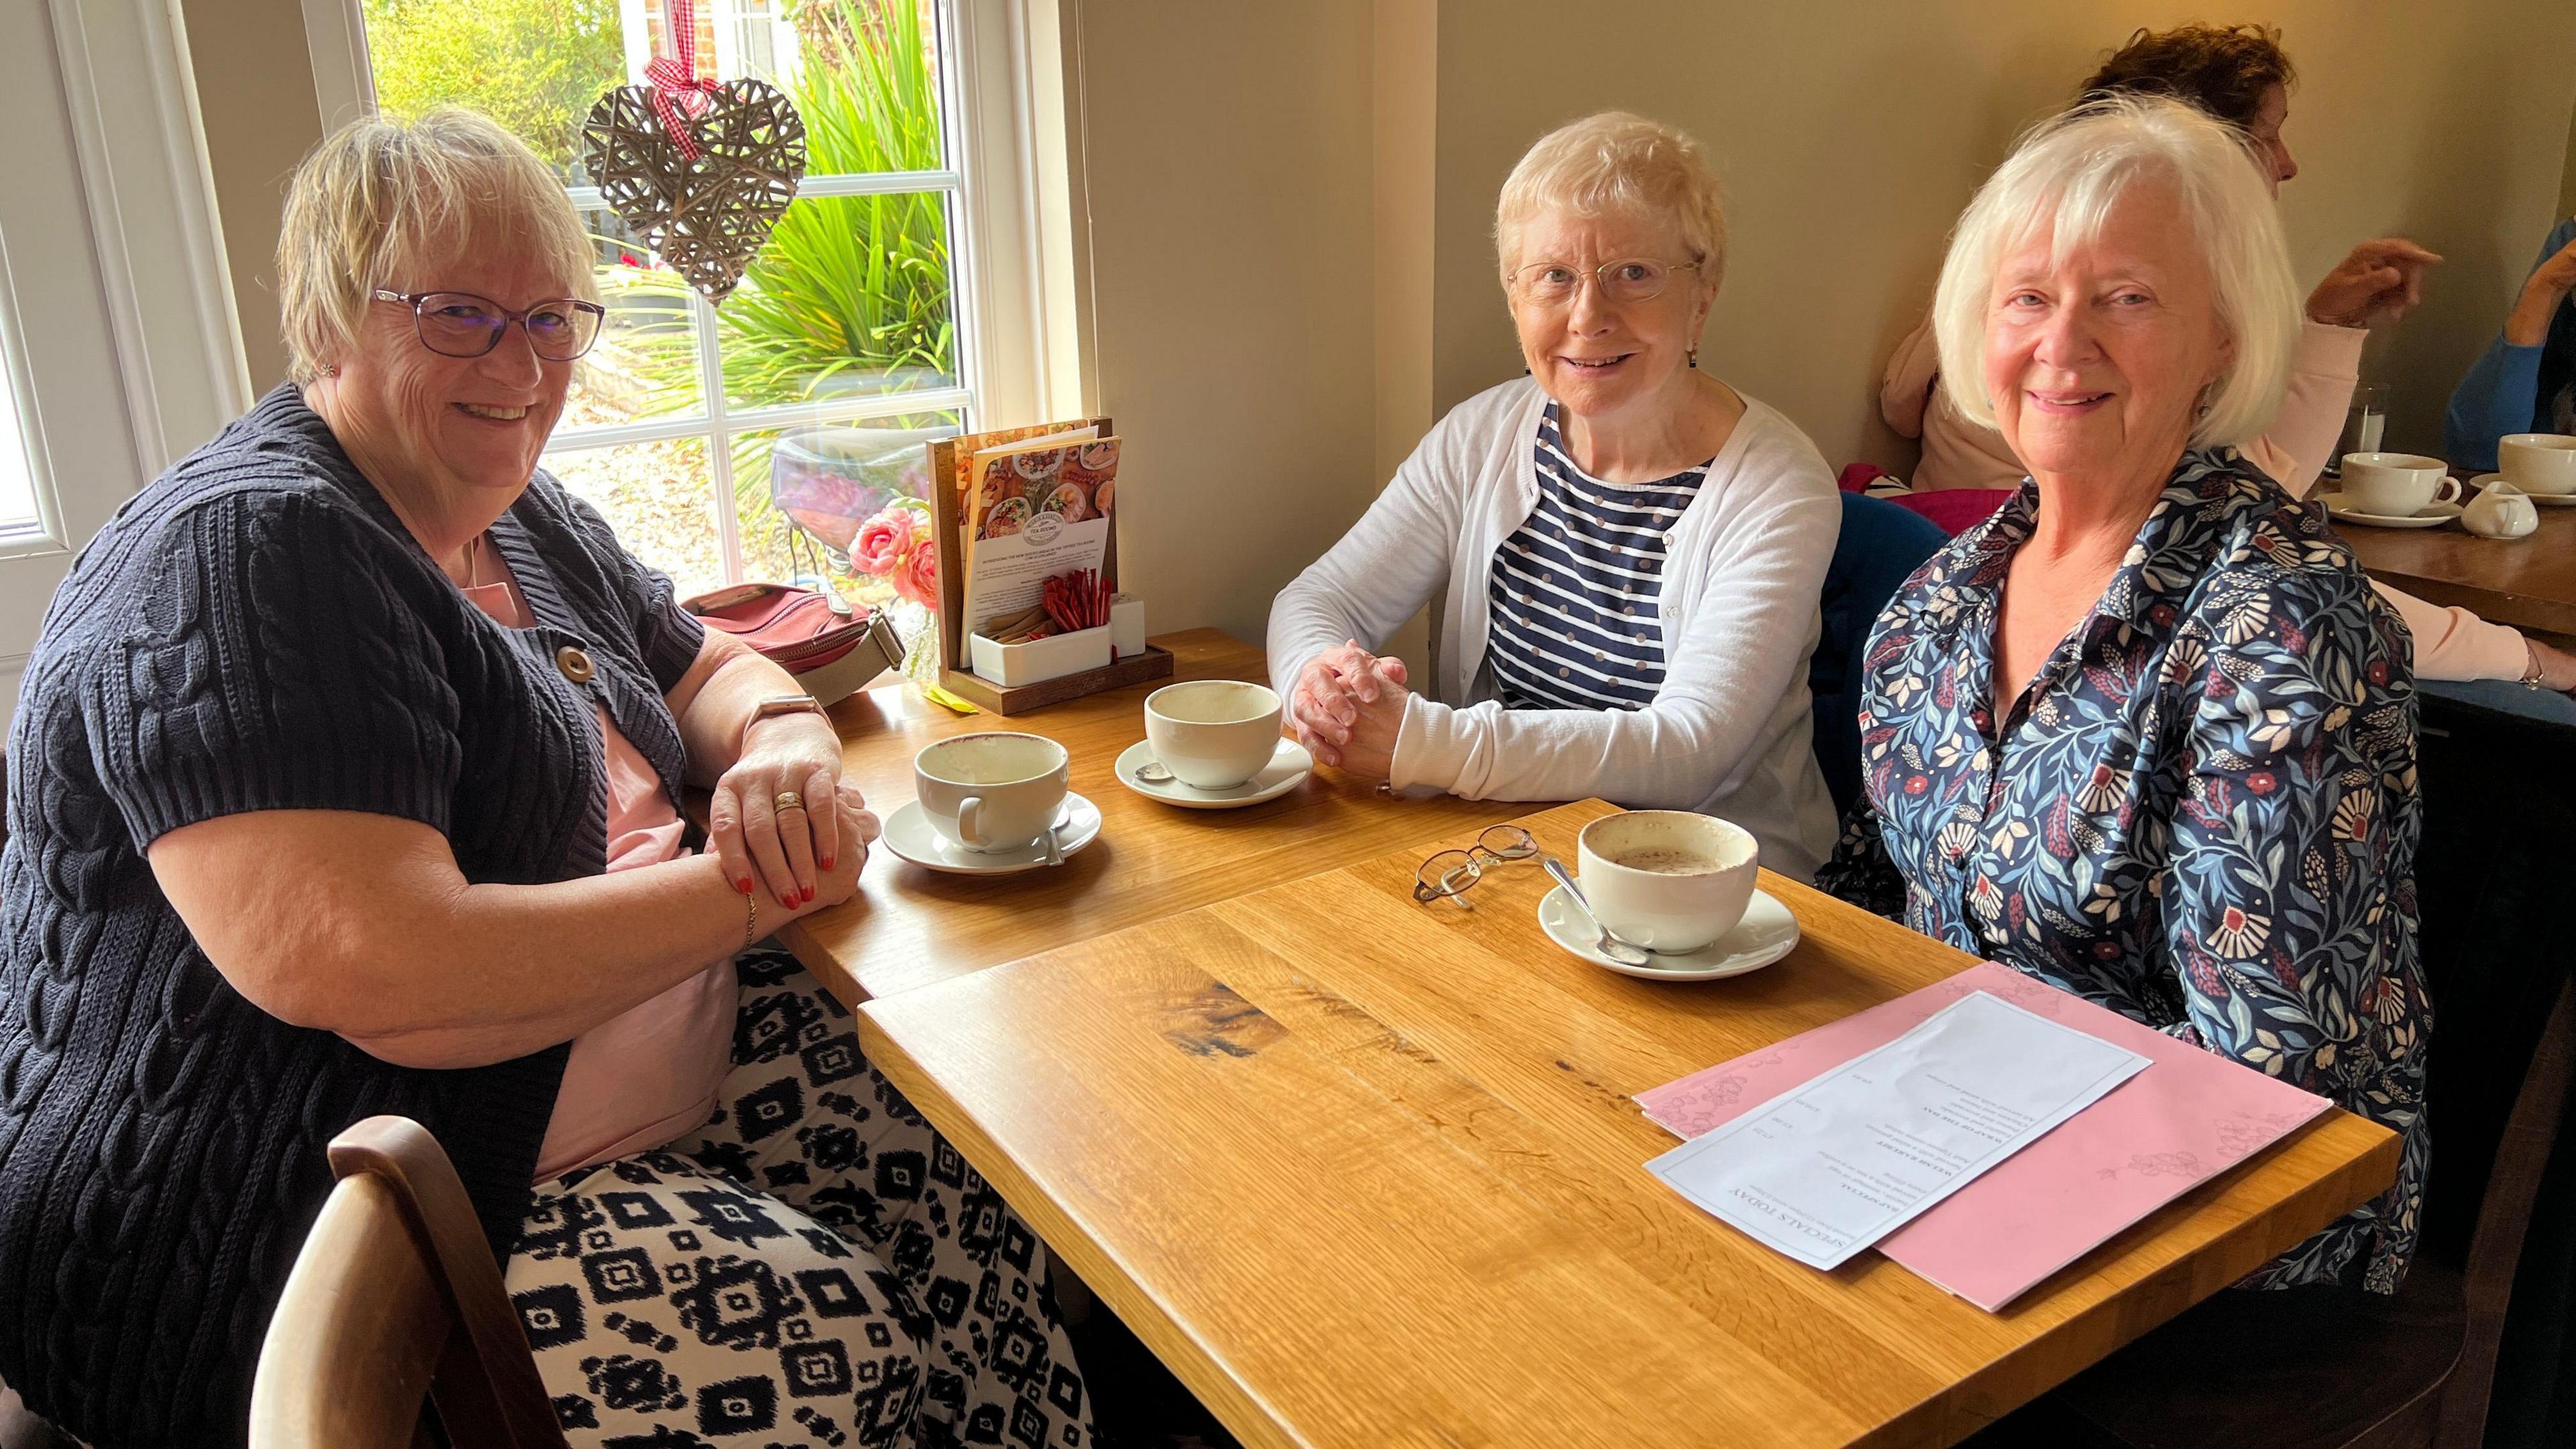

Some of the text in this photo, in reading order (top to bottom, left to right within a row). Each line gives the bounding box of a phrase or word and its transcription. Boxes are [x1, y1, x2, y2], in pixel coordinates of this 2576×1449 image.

[1945, 1083, 1961, 1091] and
[1960, 1089, 1980, 1099] salad
[1960, 1097, 1982, 1110] bacon
[1980, 1098, 1997, 1107] with
[1921, 1106, 1941, 1117] DAY
[1939, 1106, 1970, 1120] avocado
[1949, 1102, 1980, 1116] avocado
[1996, 1105, 2023, 1117] served
[1941, 1116, 1960, 1126] THE
[1980, 1114, 1995, 1122] and
[1997, 1113, 2028, 1128] Chicken
[1865, 1123, 1892, 1138] garnish
[1890, 1137, 1912, 1147] salad
[1973, 1130, 2002, 1144] WRAP
[1875, 1140, 1952, 1177] WELSH RAREBIT
[1918, 1148, 1934, 1158] with
[1952, 1154, 1971, 1164] And
[1934, 1156, 1962, 1171] Served
[1874, 1178, 1891, 1188] with
[1840, 1182, 1900, 1213] BAP SPECIAL
[1890, 1187, 1918, 1200] served
[1727, 1188, 1843, 1247] SPECIALS TODAY
